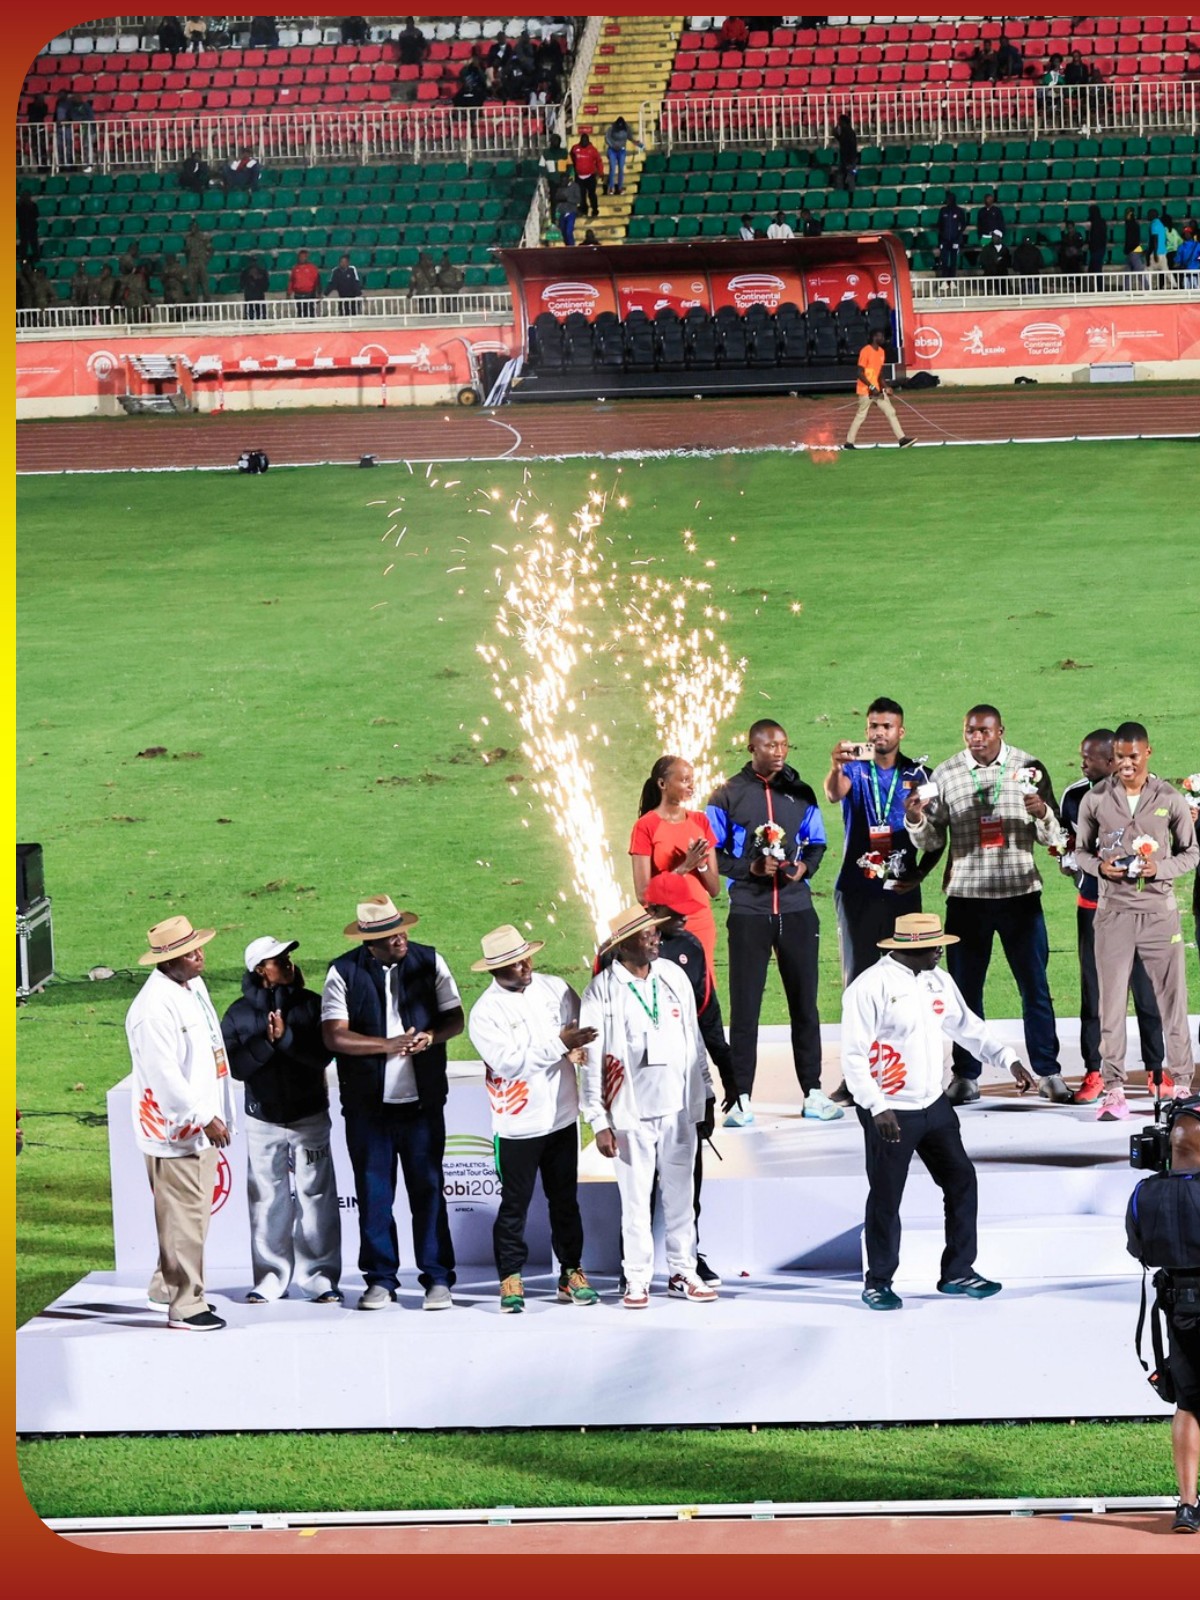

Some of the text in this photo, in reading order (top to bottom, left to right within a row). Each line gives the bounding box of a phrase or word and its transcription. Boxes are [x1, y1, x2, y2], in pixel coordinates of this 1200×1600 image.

[734, 292, 781, 301] Continental
[547, 300, 596, 310] Continental
[914, 336, 939, 346] absa
[443, 1180, 502, 1196] obi202
